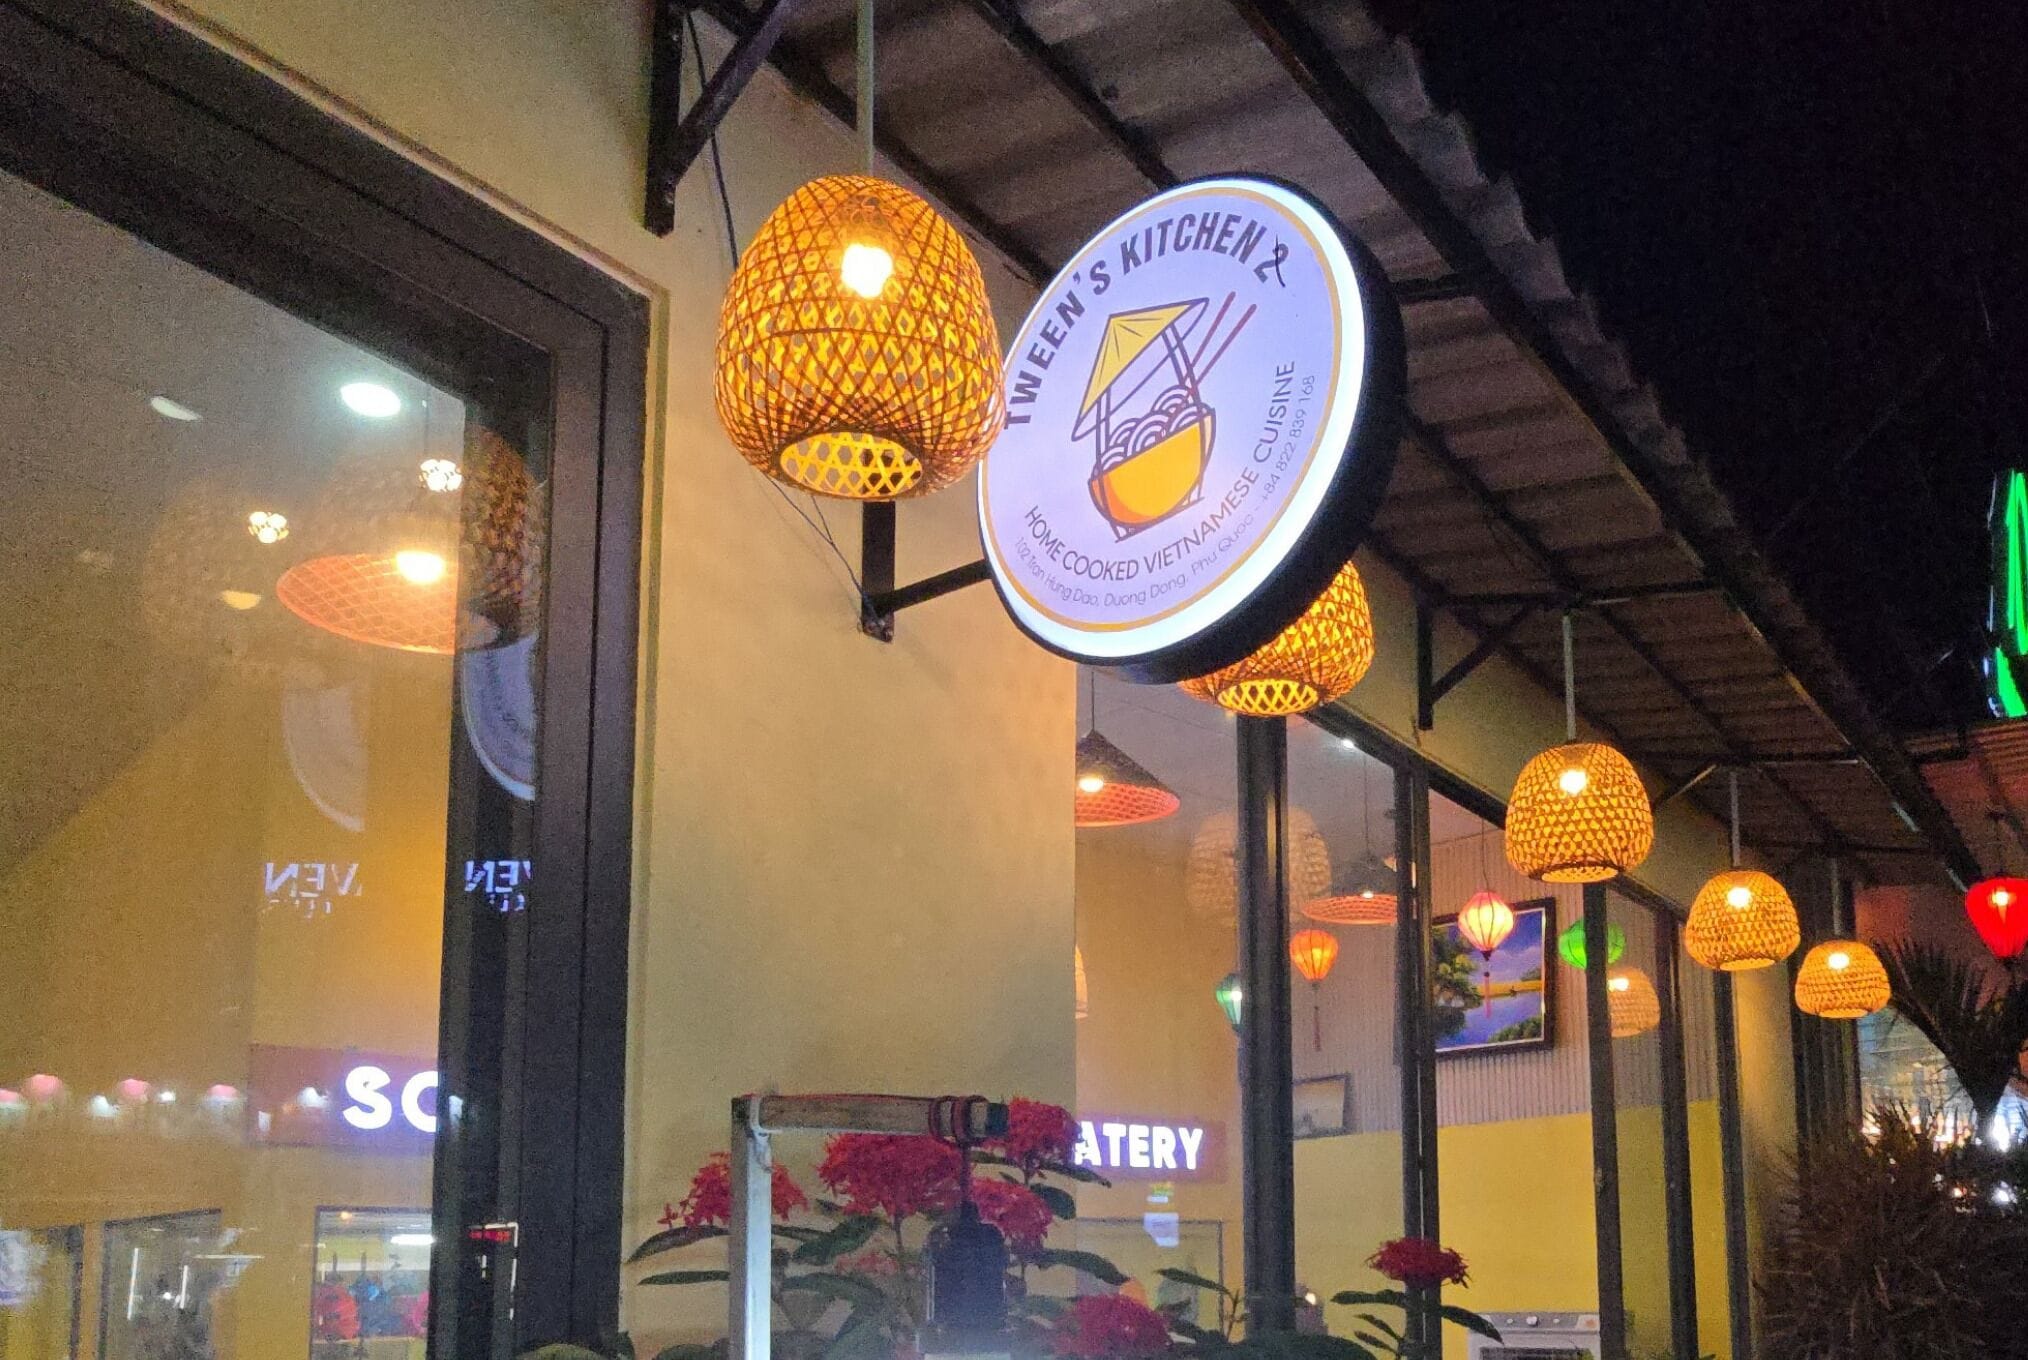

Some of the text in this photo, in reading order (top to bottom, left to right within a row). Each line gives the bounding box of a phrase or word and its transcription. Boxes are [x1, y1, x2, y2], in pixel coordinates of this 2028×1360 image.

[1004, 260, 1111, 430] TWEEN'S
[1121, 212, 1267, 275] KITCHEN
[1298, 375, 1315, 402] 168
[1289, 409, 1308, 438] 839
[1025, 361, 1295, 580] HOME COOKED VIETNAMESE CUISINE
[1275, 442, 1297, 472] 822
[1191, 551, 1218, 575] Phu
[1103, 591, 1147, 607] Duong
[1074, 1121, 1203, 1170] ATERY
